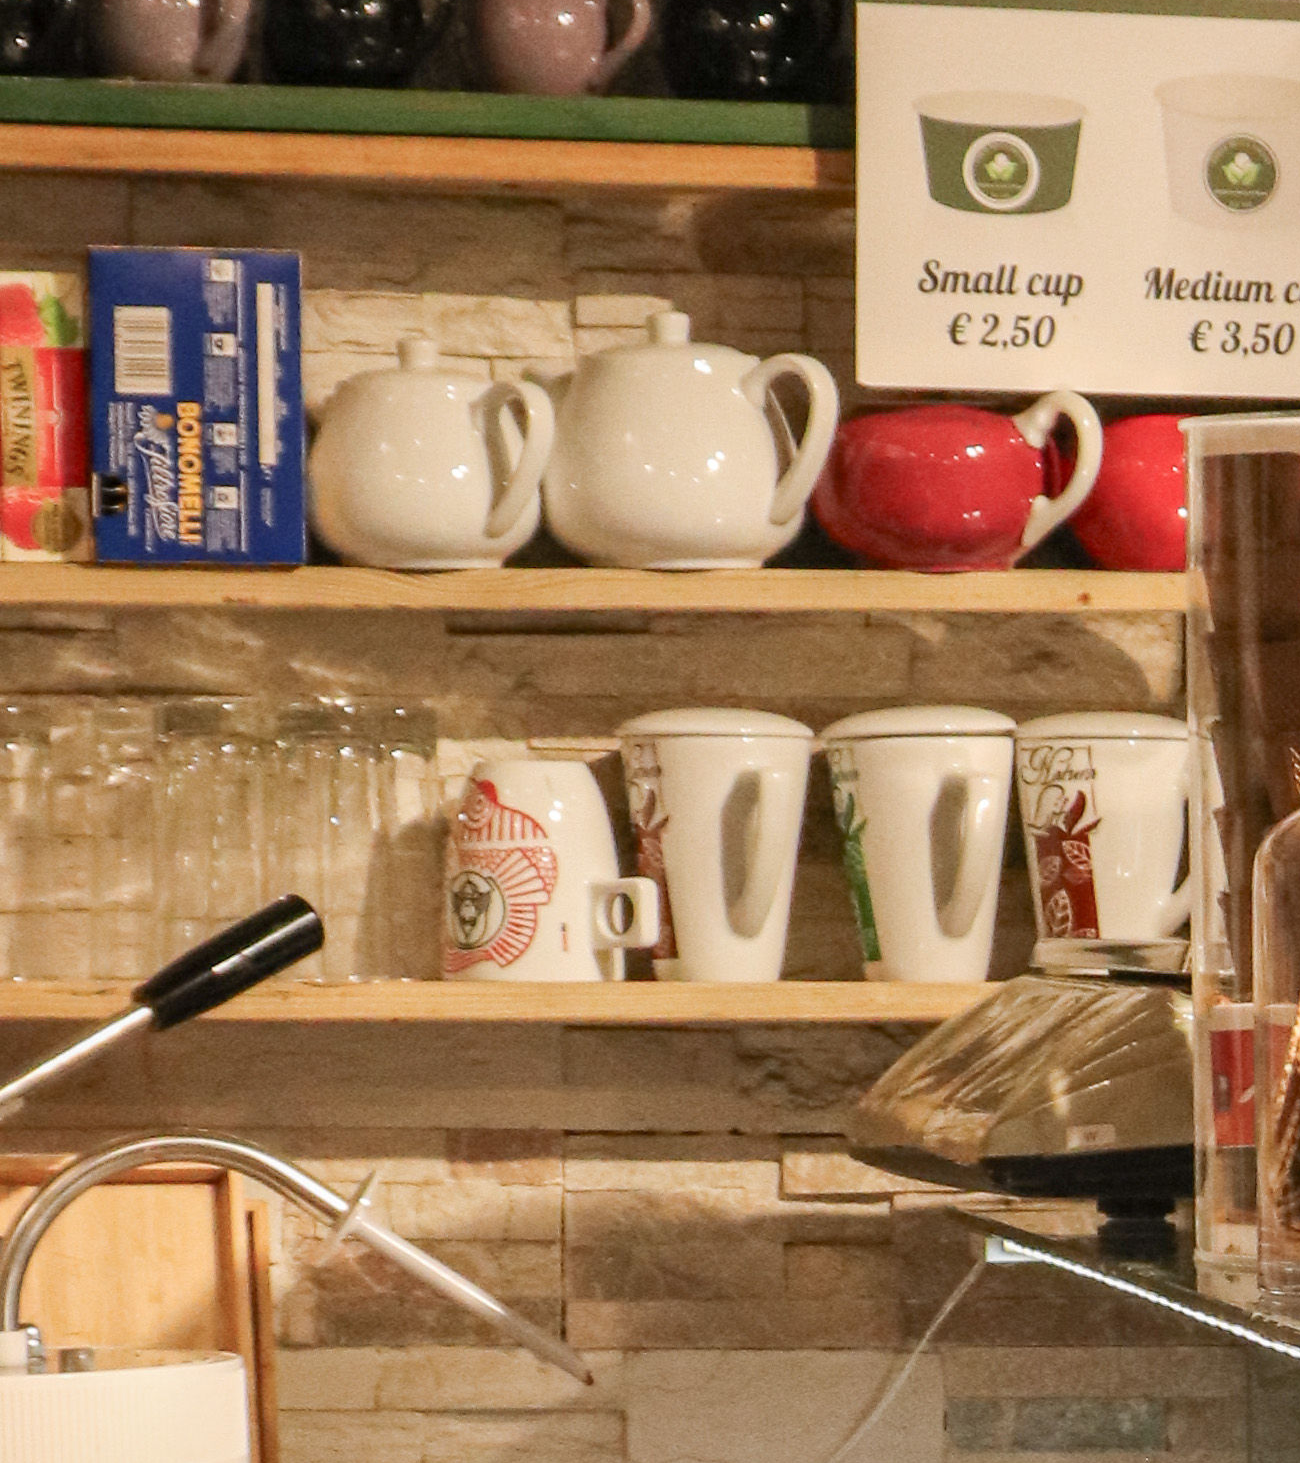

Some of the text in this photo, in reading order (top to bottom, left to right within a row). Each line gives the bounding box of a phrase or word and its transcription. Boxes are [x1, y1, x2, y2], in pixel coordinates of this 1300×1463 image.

[918, 260, 1084, 307] Small cup
[1145, 268, 1274, 304] Medium
[948, 313, 1056, 349] € 2,50
[1189, 321, 1296, 356] € 3,50
[6, 361, 32, 476] TWININGS
[176, 401, 203, 545] BONOMELLI
